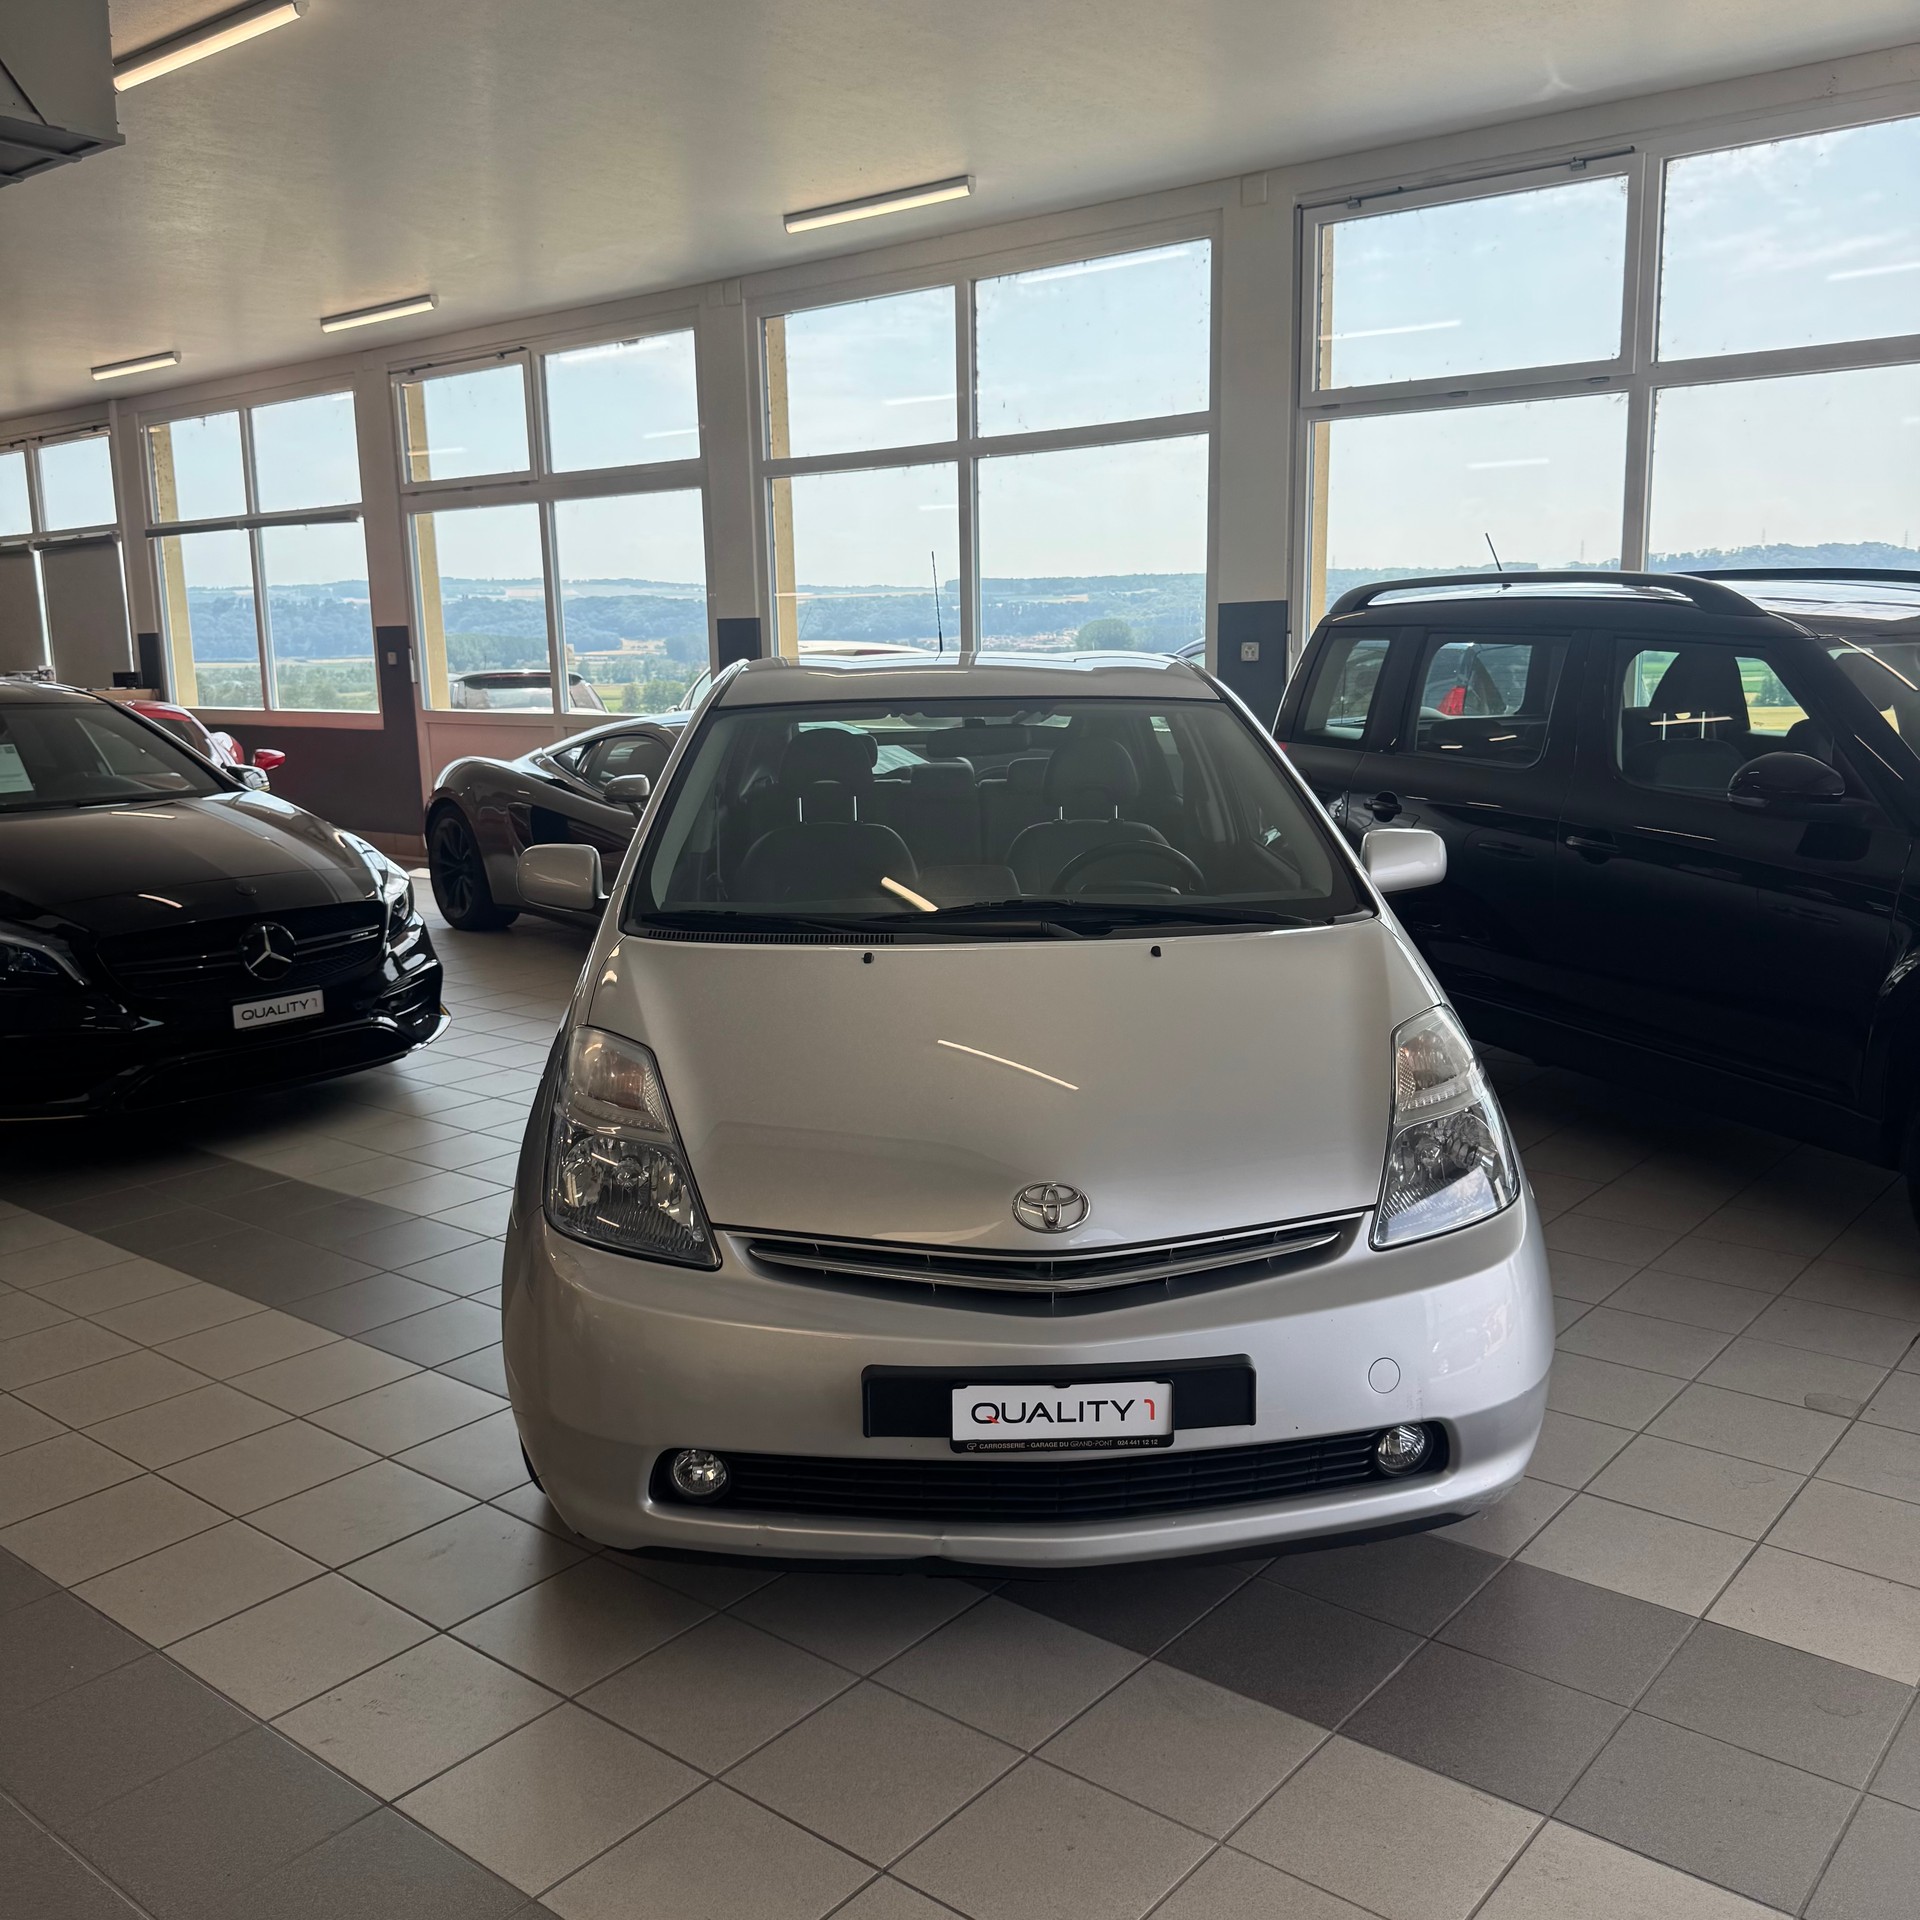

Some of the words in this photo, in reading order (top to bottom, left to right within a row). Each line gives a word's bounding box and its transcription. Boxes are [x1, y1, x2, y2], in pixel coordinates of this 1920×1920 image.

[241, 999, 309, 1020] QUALITY
[971, 1400, 1135, 1424] QUALITY
[1144, 1399, 1155, 1420] 1
[979, 1442, 1026, 1450] CARROSSERIE
[1030, 1441, 1058, 1449] GARAGE
[1059, 1440, 1069, 1448] DU
